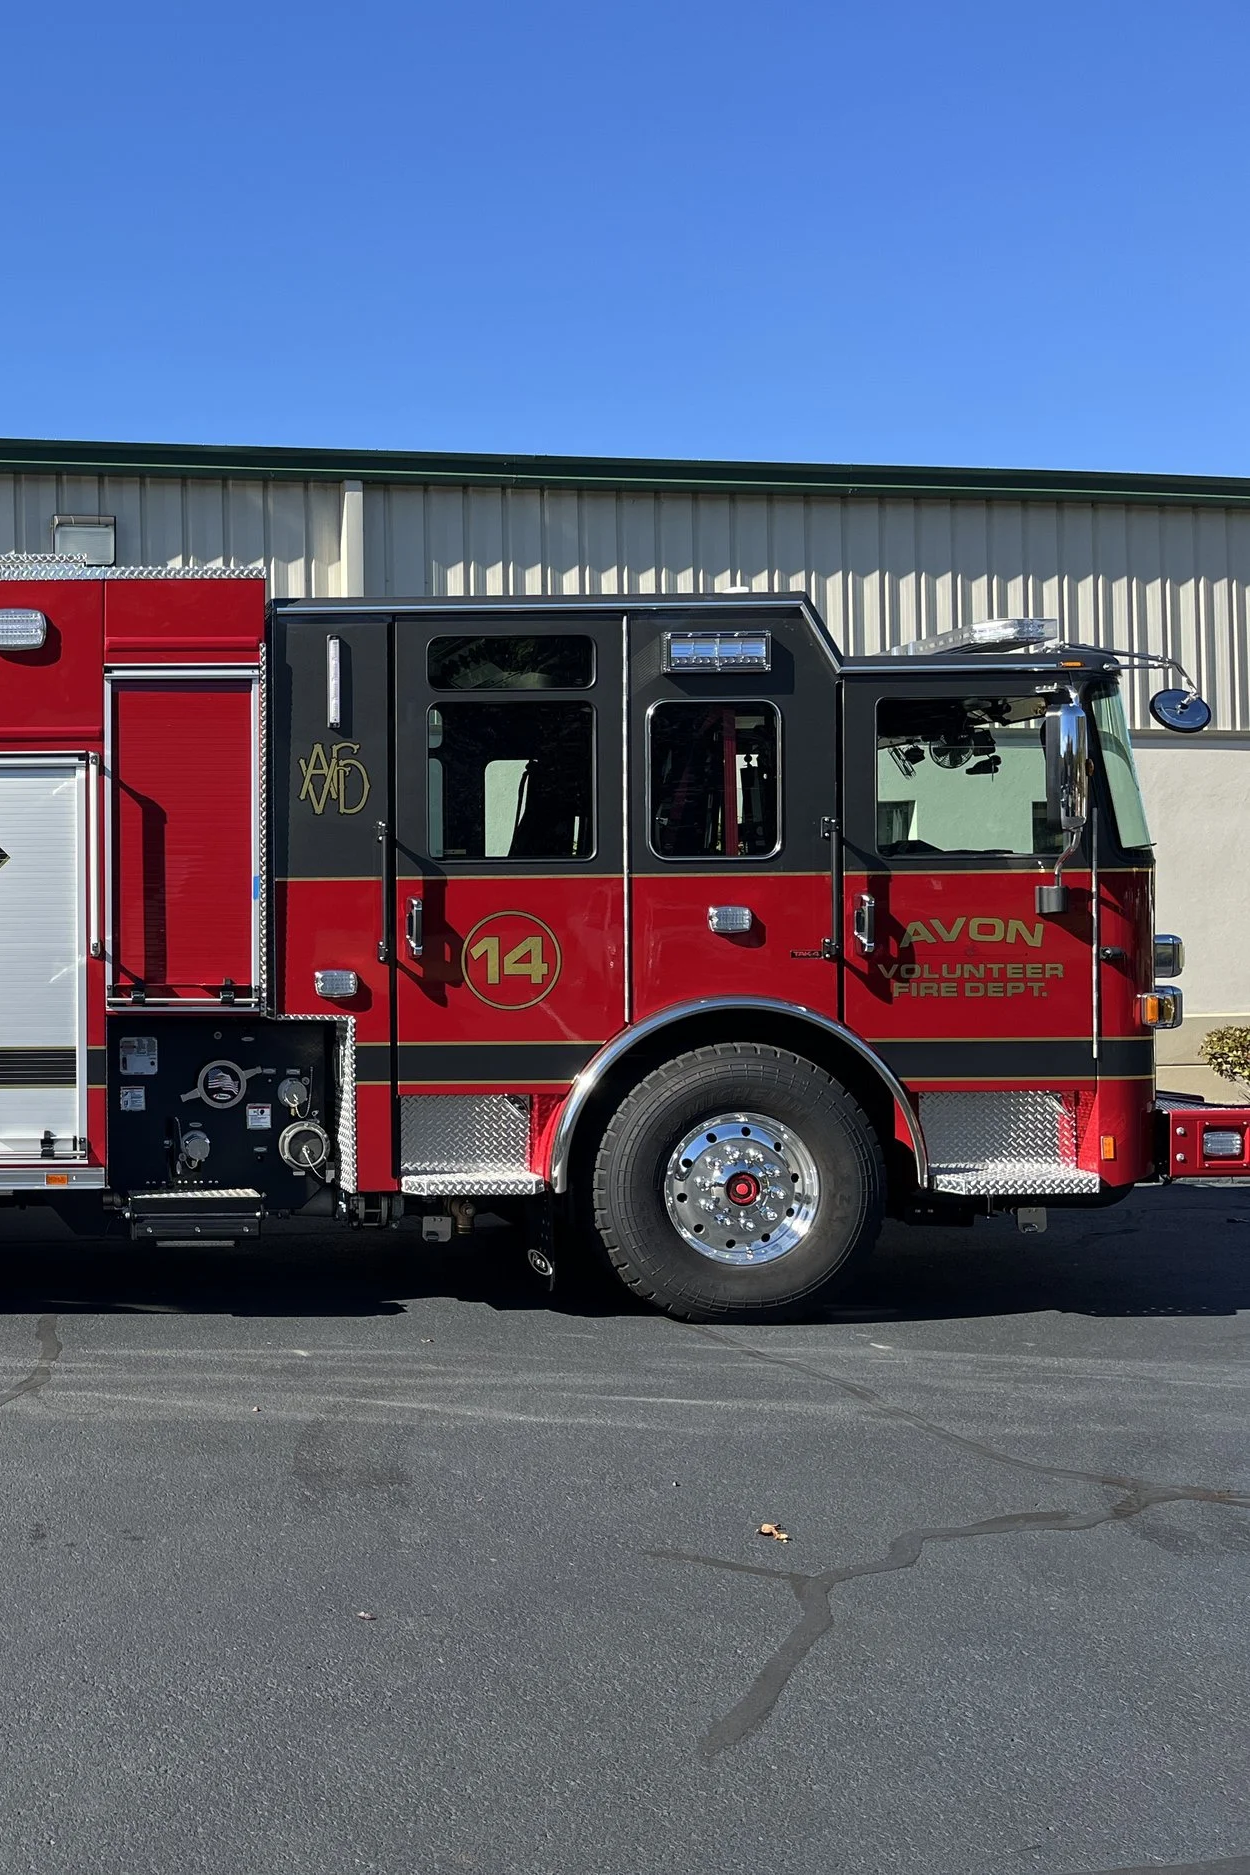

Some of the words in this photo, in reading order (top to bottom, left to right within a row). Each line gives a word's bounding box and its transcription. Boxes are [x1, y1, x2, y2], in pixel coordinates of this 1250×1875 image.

[900, 917, 1044, 948] AVON
[470, 936, 549, 984] 14
[878, 964, 1064, 979] VOLUNTEER
[893, 982, 958, 998] FIRE
[964, 982, 1048, 998] DEPT.
